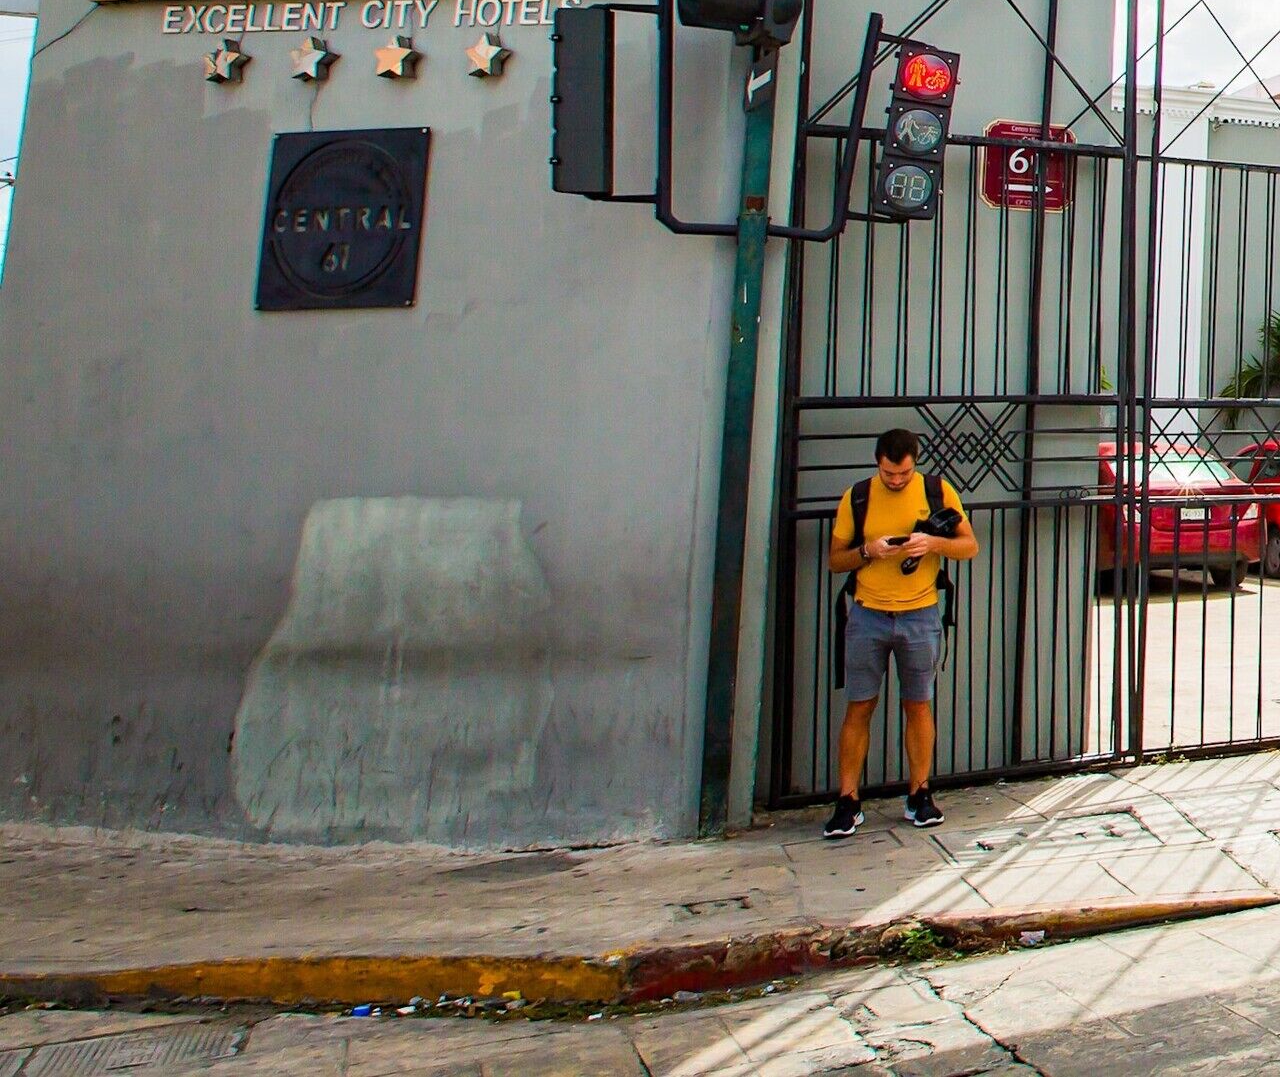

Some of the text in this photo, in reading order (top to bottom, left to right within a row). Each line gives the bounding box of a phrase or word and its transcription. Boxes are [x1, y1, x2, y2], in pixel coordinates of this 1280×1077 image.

[163, 2, 346, 34] EXCELLENT
[361, 0, 437, 28] CITY
[274, 205, 412, 234] CENTRAL
